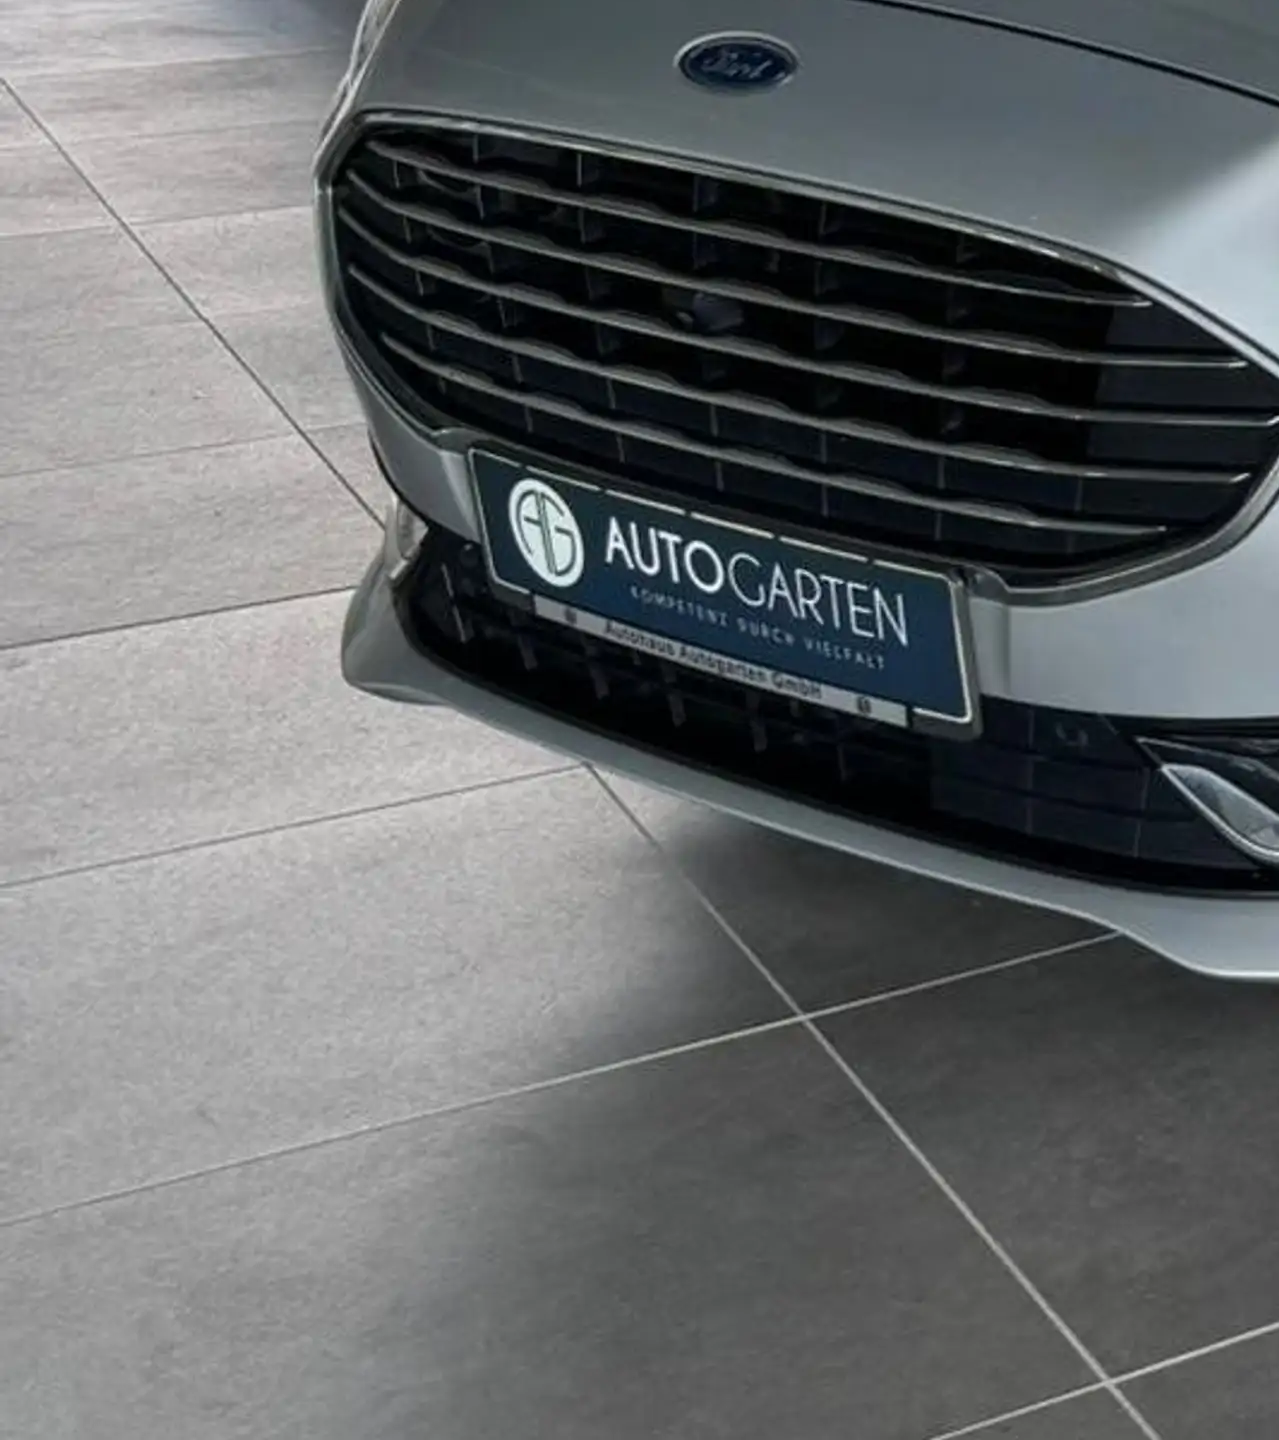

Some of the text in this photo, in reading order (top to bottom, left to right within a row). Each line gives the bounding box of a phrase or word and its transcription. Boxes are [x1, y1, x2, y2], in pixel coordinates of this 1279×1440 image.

[604, 516, 909, 647] AUTOGARTEN
[605, 619, 676, 657] Autohaus
[772, 668, 823, 700] GmbH
[803, 636, 886, 670] VIELFALT
